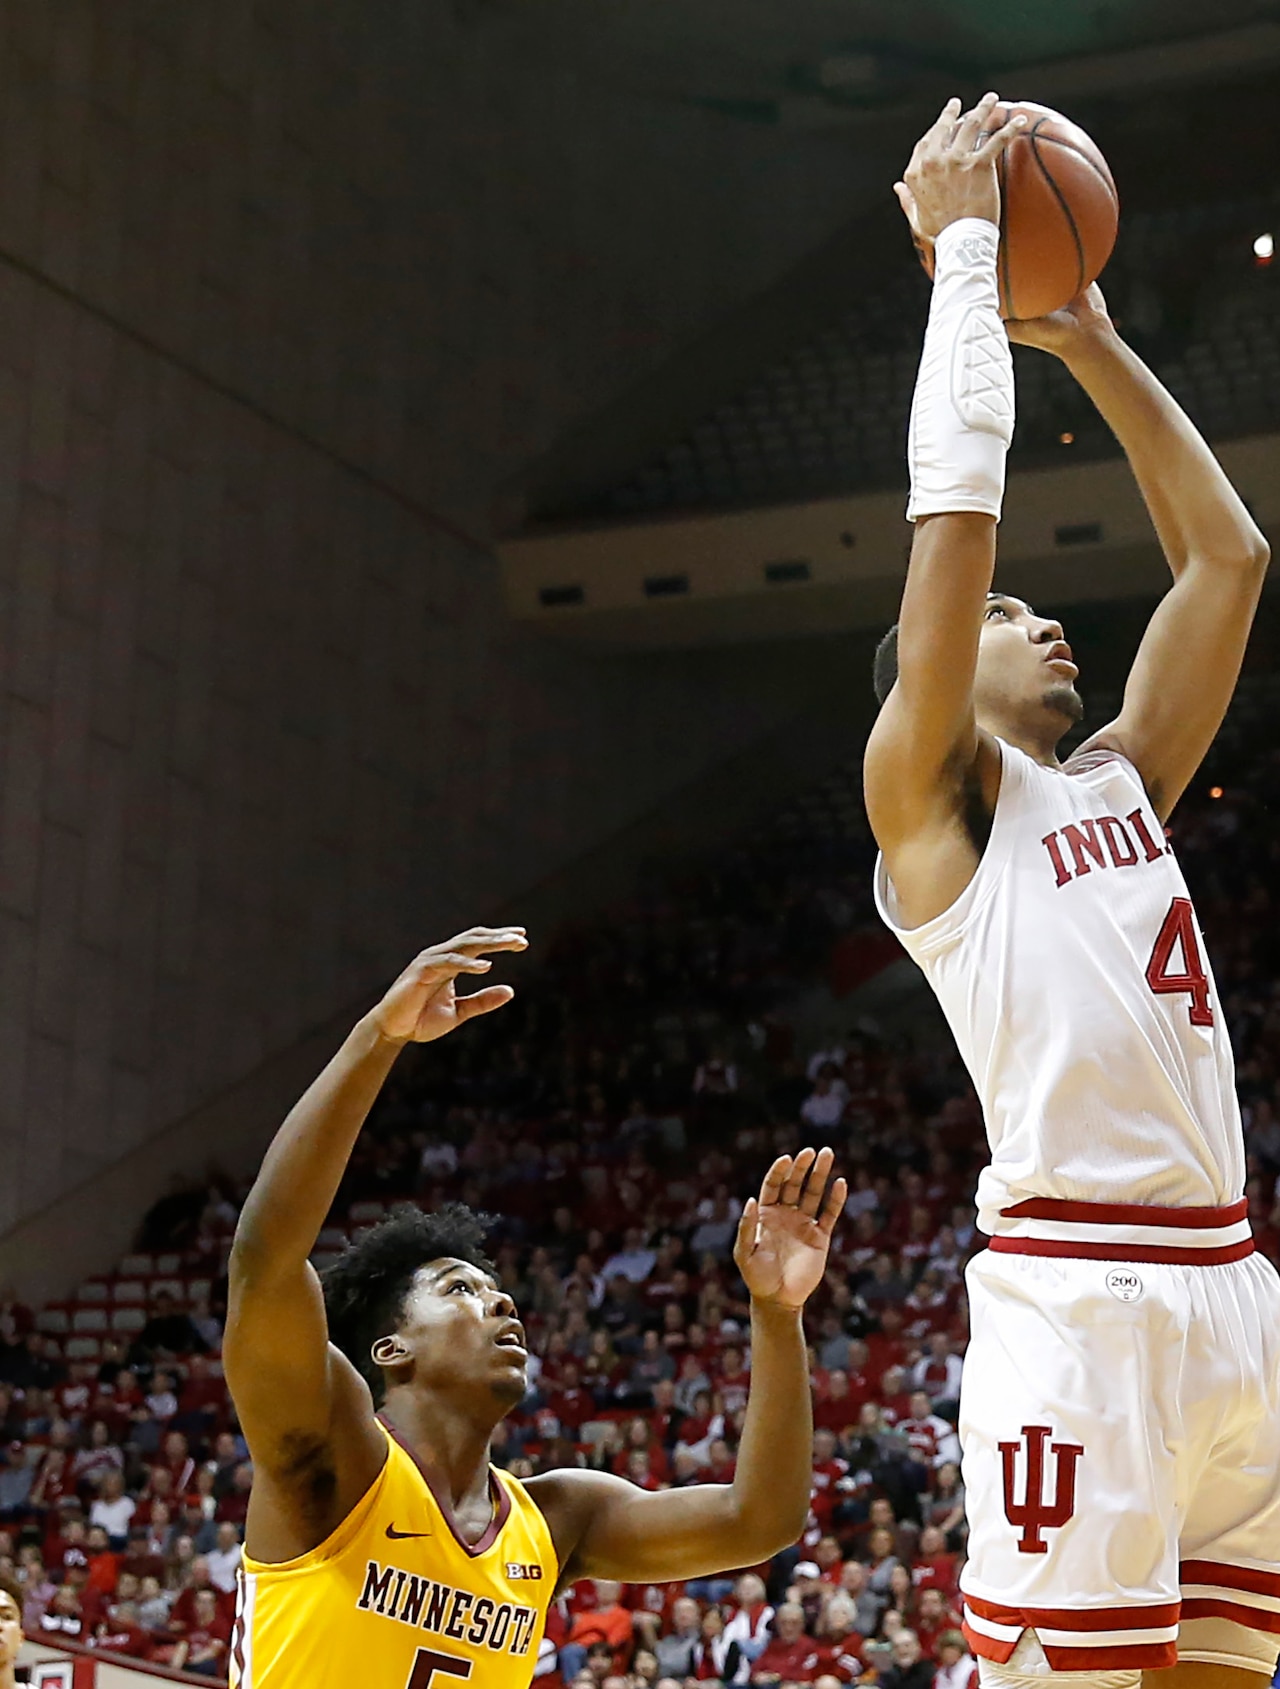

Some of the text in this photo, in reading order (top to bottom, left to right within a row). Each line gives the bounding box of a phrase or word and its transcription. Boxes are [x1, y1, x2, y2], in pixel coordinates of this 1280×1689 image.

[1041, 807, 1173, 889] INDI
[1145, 896, 1214, 1028] 4
[1111, 1275, 1138, 1287] 200
